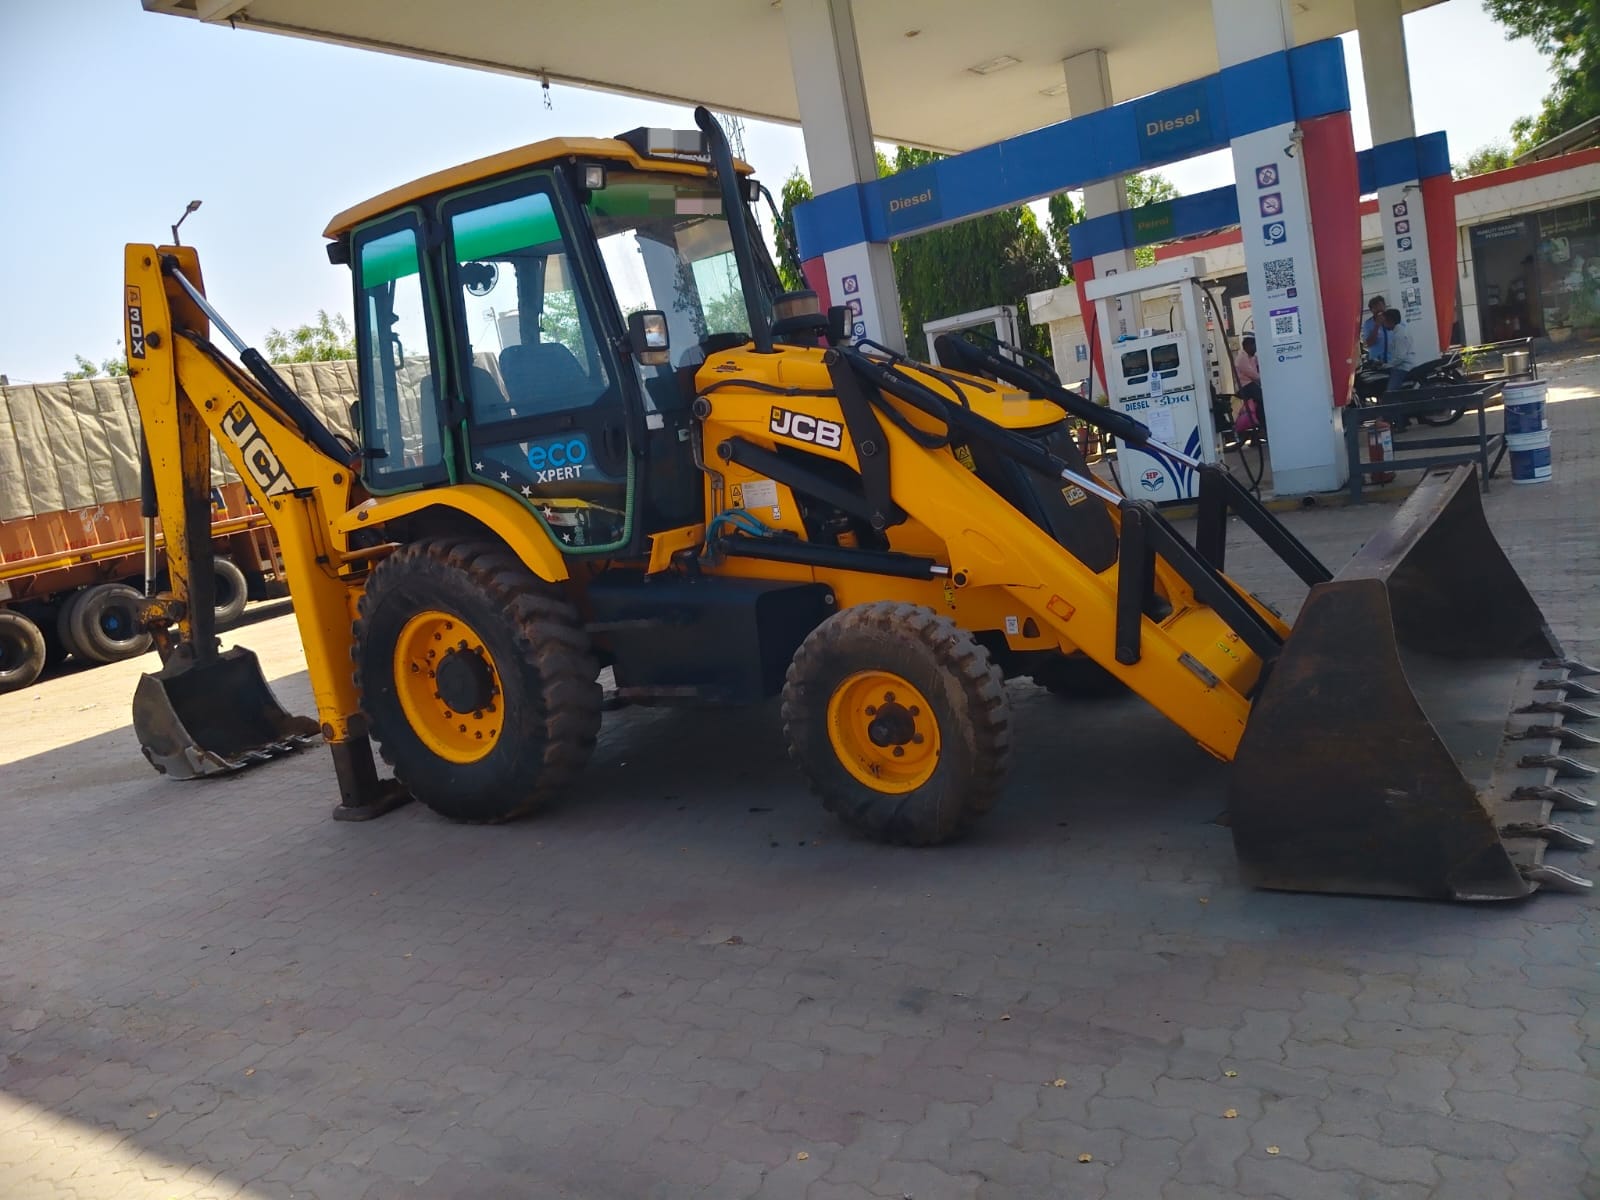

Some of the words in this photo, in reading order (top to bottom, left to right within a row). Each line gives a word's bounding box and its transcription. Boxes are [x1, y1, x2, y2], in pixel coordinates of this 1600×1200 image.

[1146, 108, 1201, 137] Diesel
[889, 188, 933, 213] Diesel
[129, 307, 145, 355] 3DX
[1125, 399, 1150, 412] DIESEL
[771, 410, 842, 449] JCB
[527, 439, 587, 470] eco
[536, 464, 583, 484] XPERT
[1145, 471, 1159, 480] HP
[1065, 486, 1085, 502] JCB
